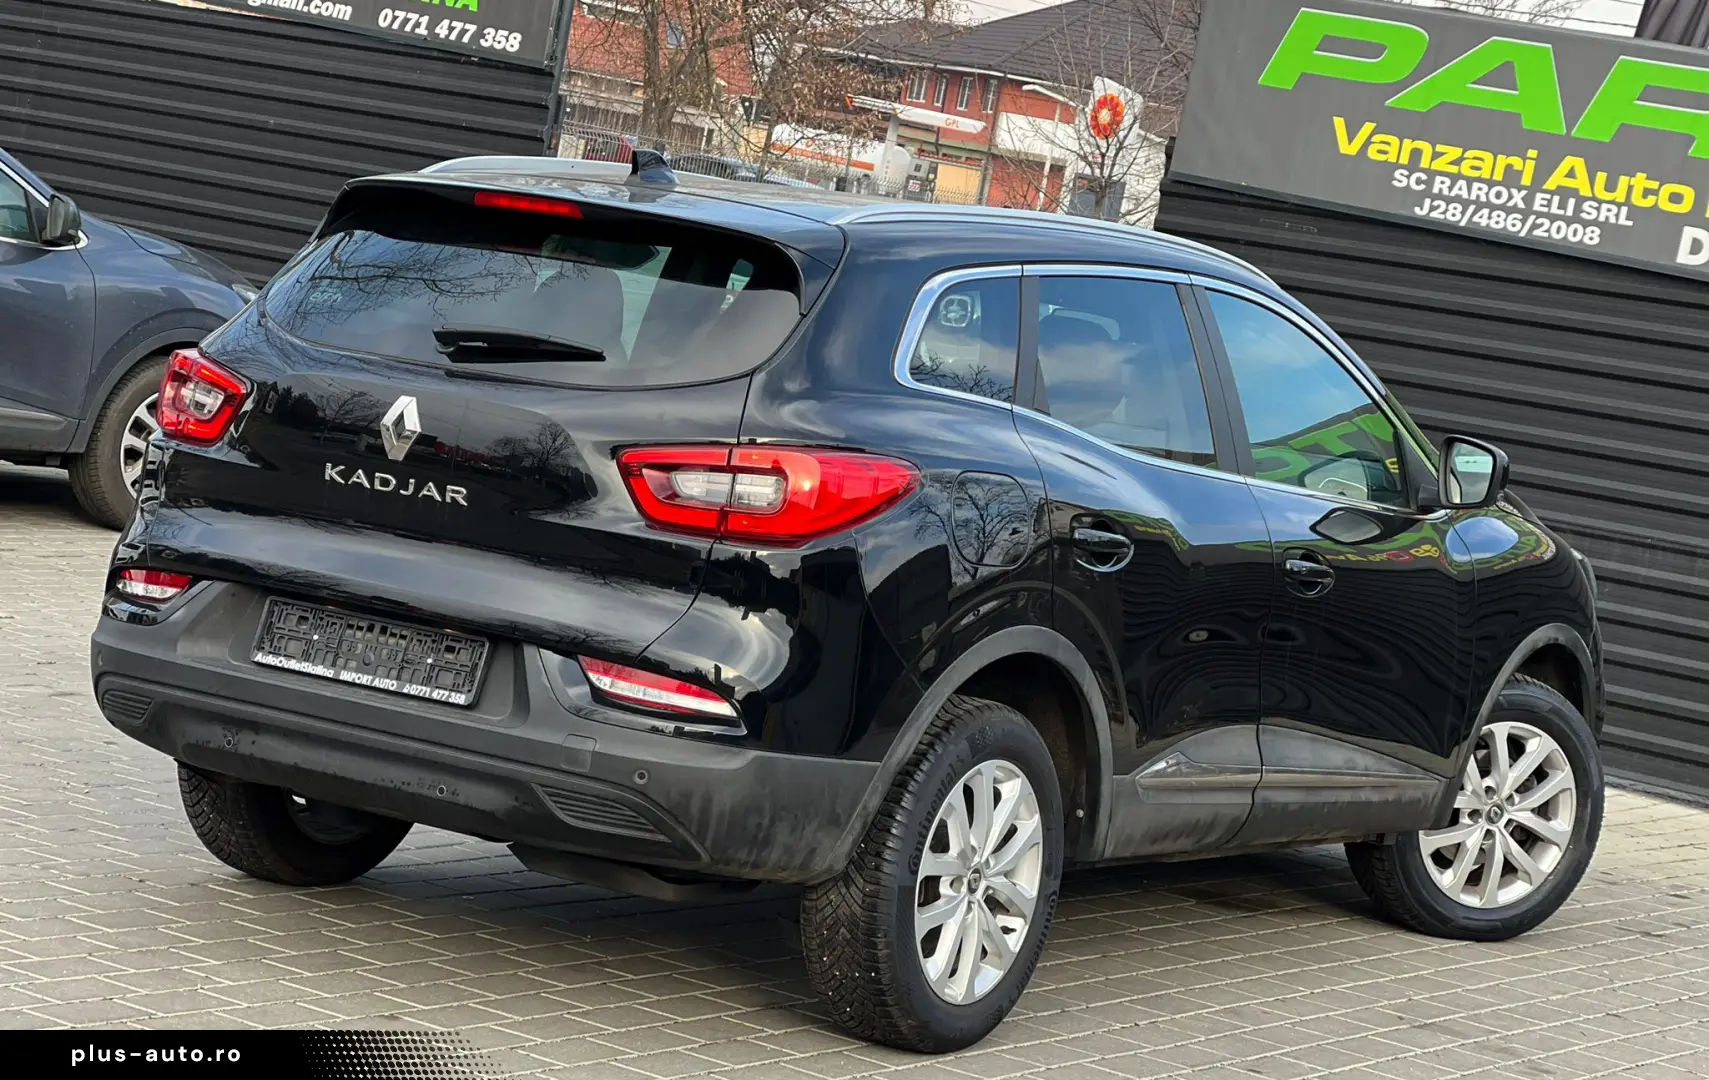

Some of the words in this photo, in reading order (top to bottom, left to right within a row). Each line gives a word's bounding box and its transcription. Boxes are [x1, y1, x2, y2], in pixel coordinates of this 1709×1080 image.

[377, 7, 430, 36] 0771
[434, 18, 478, 44] 477
[479, 27, 523, 53] 358
[944, 117, 961, 130] GPL
[1332, 116, 1539, 185] Vanzari
[1542, 155, 1696, 214] Auto
[1391, 168, 1429, 191] SC
[1432, 175, 1530, 209] RAROX
[1533, 192, 1577, 217] ELI
[1580, 200, 1634, 227] SRL
[1413, 197, 1602, 246] J28/486/2008
[323, 461, 469, 507] KADJAR
[254, 652, 335, 679] AutoOutletSlatina
[339, 669, 375, 686] IMPORT
[373, 677, 398, 691] AUTO
[432, 688, 450, 701] 477
[449, 691, 467, 705] 358
